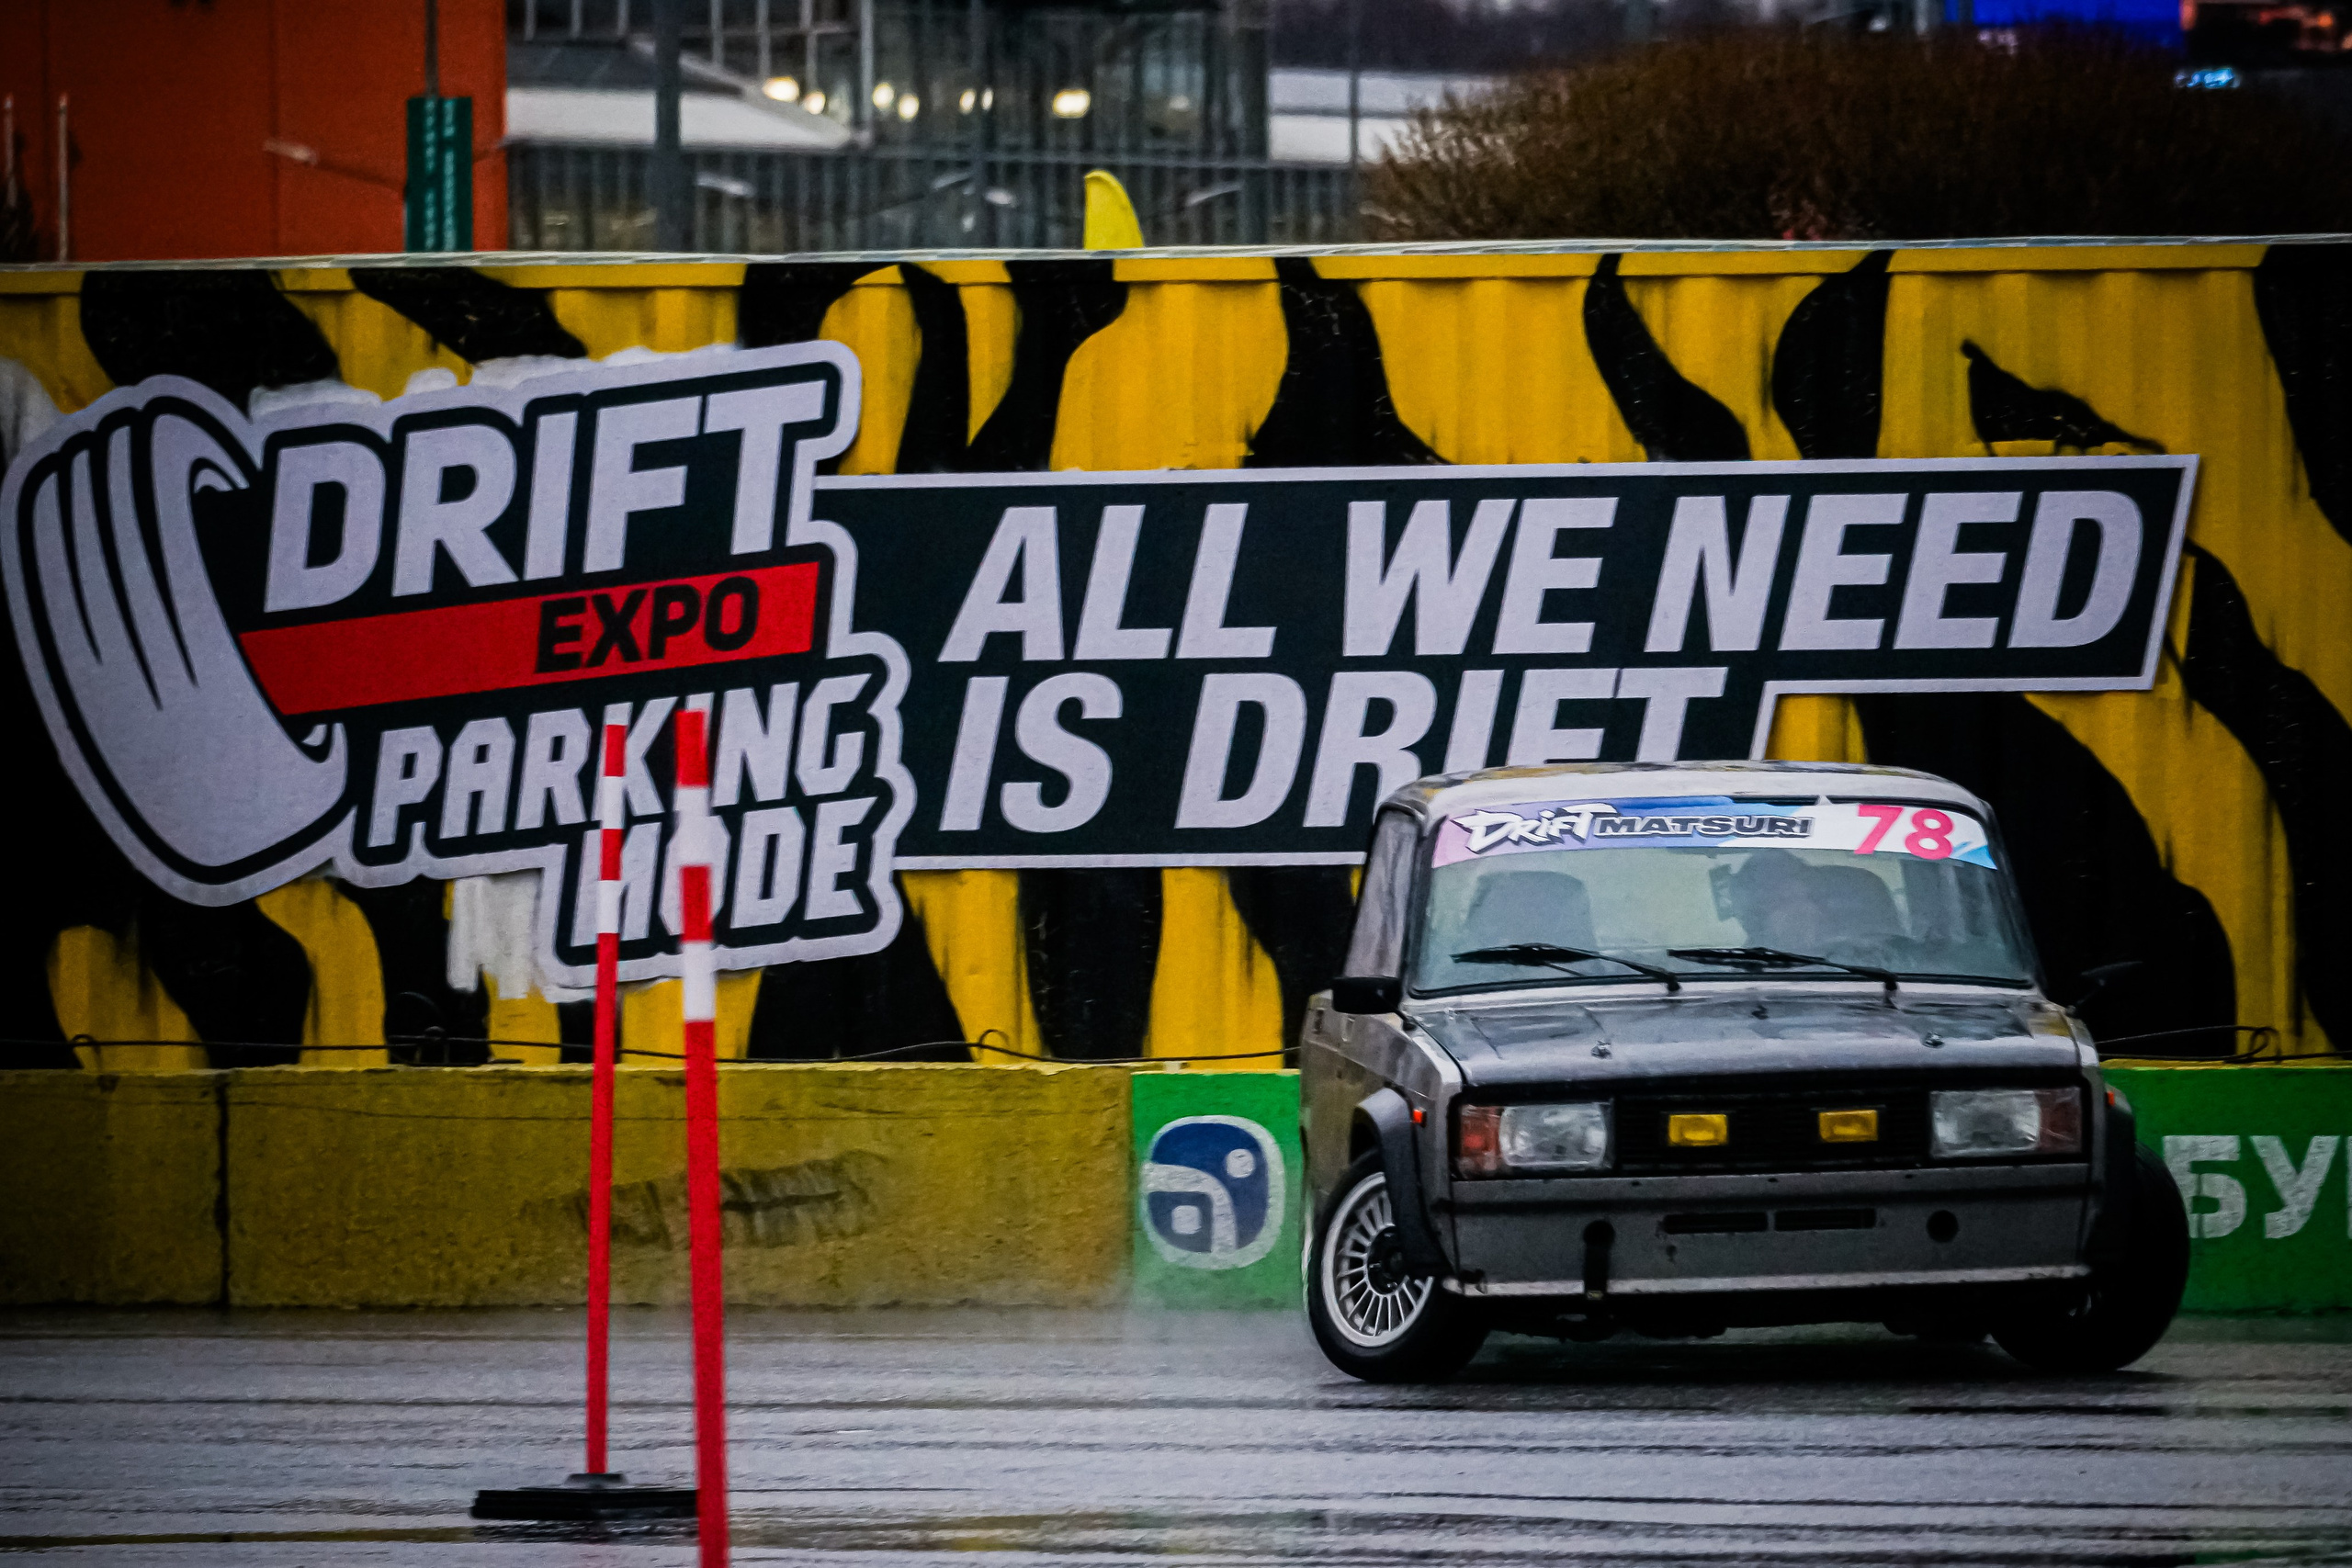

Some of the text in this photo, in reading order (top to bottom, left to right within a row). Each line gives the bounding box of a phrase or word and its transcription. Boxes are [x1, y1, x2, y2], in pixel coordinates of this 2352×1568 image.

[264, 379, 825, 613] DRIFT
[535, 576, 760, 675] EXPO
[937, 491, 2143, 661] ALL WE NEED
[368, 672, 873, 847] PARKNG
[939, 667, 1728, 832] IS DRIFT
[1594, 815, 1814, 840] MATSURI
[1853, 804, 1954, 860] 78
[2162, 1134, 2352, 1239] БУ
